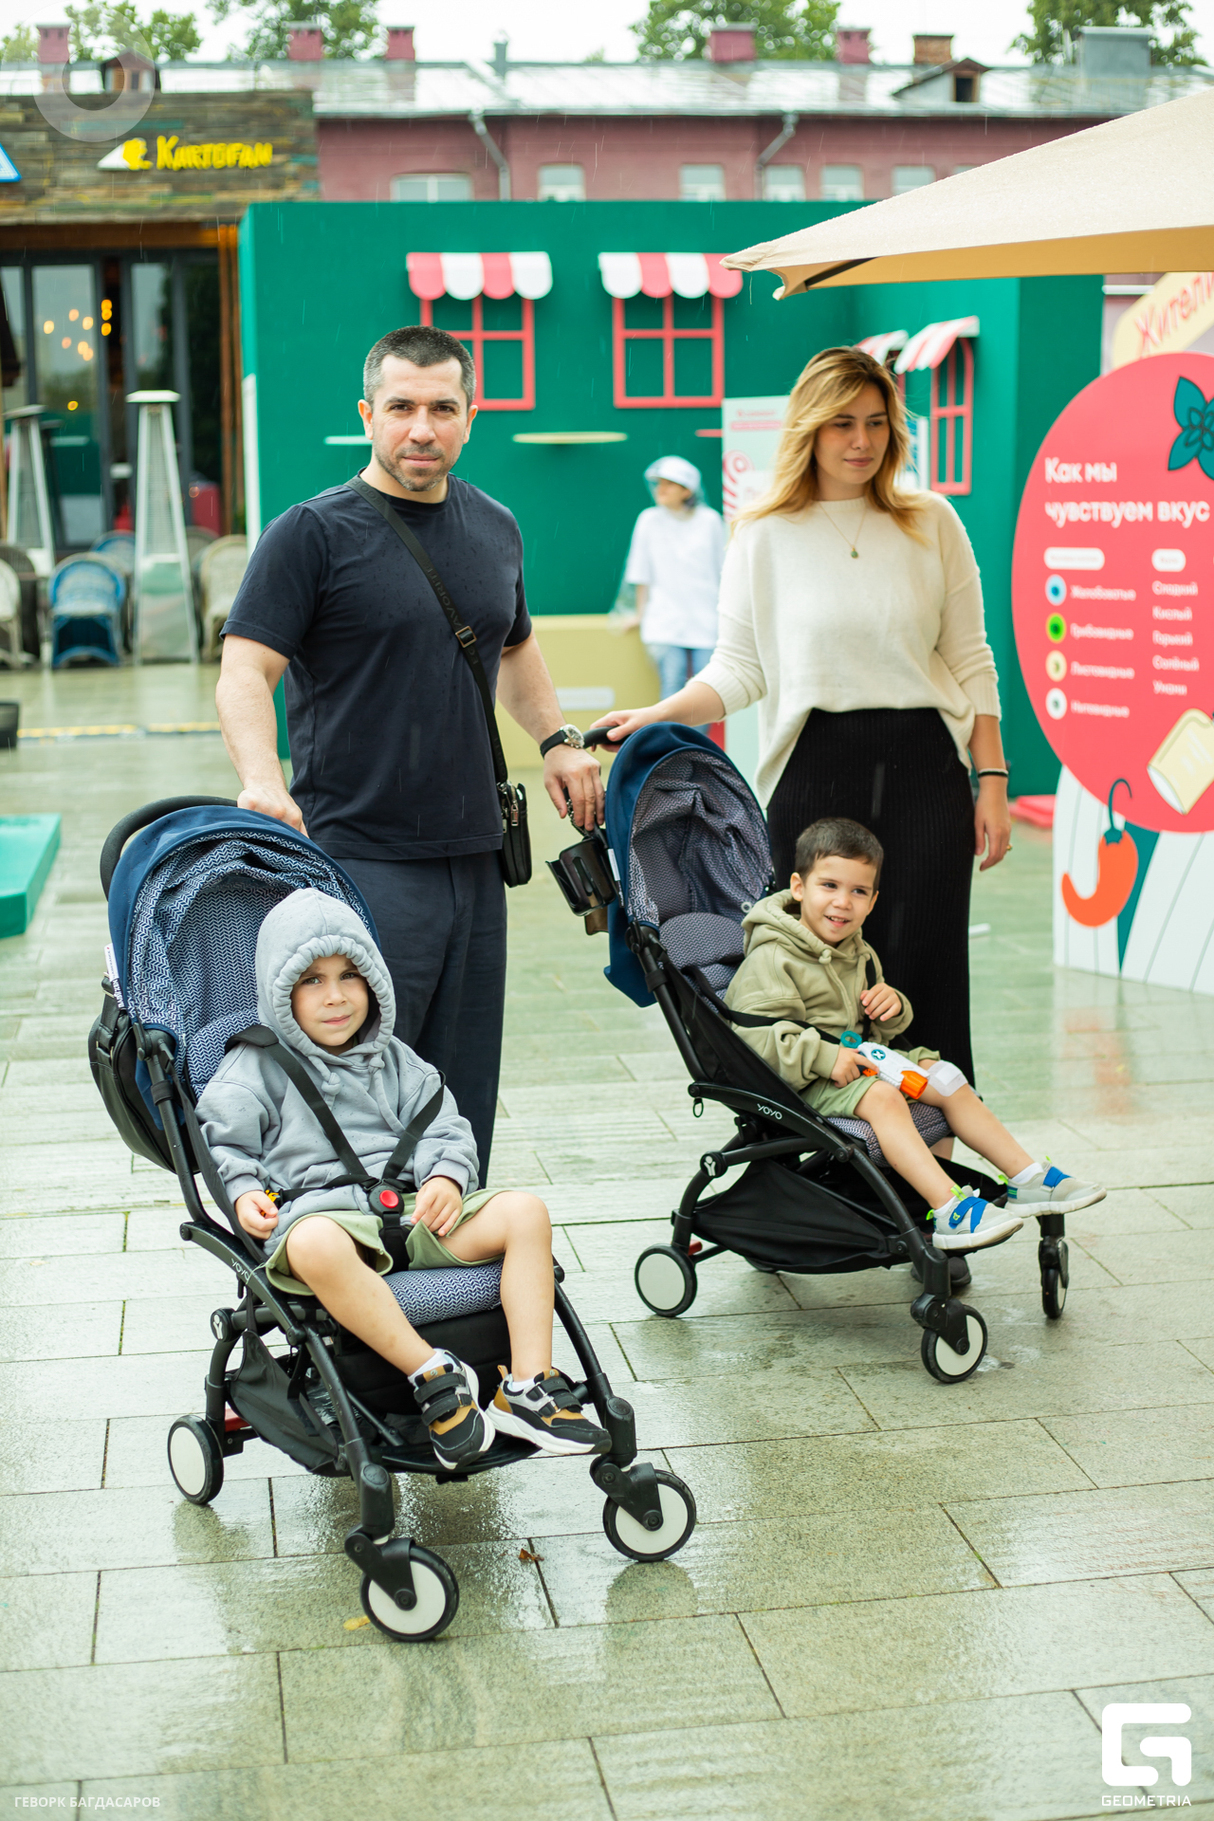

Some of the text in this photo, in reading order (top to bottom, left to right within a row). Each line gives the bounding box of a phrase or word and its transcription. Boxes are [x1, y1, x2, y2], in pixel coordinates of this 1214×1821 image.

[1045, 456, 1117, 484] Как мы
[1045, 501, 1211, 529] чувствуем вкус
[756, 1103, 783, 1120] YOYO
